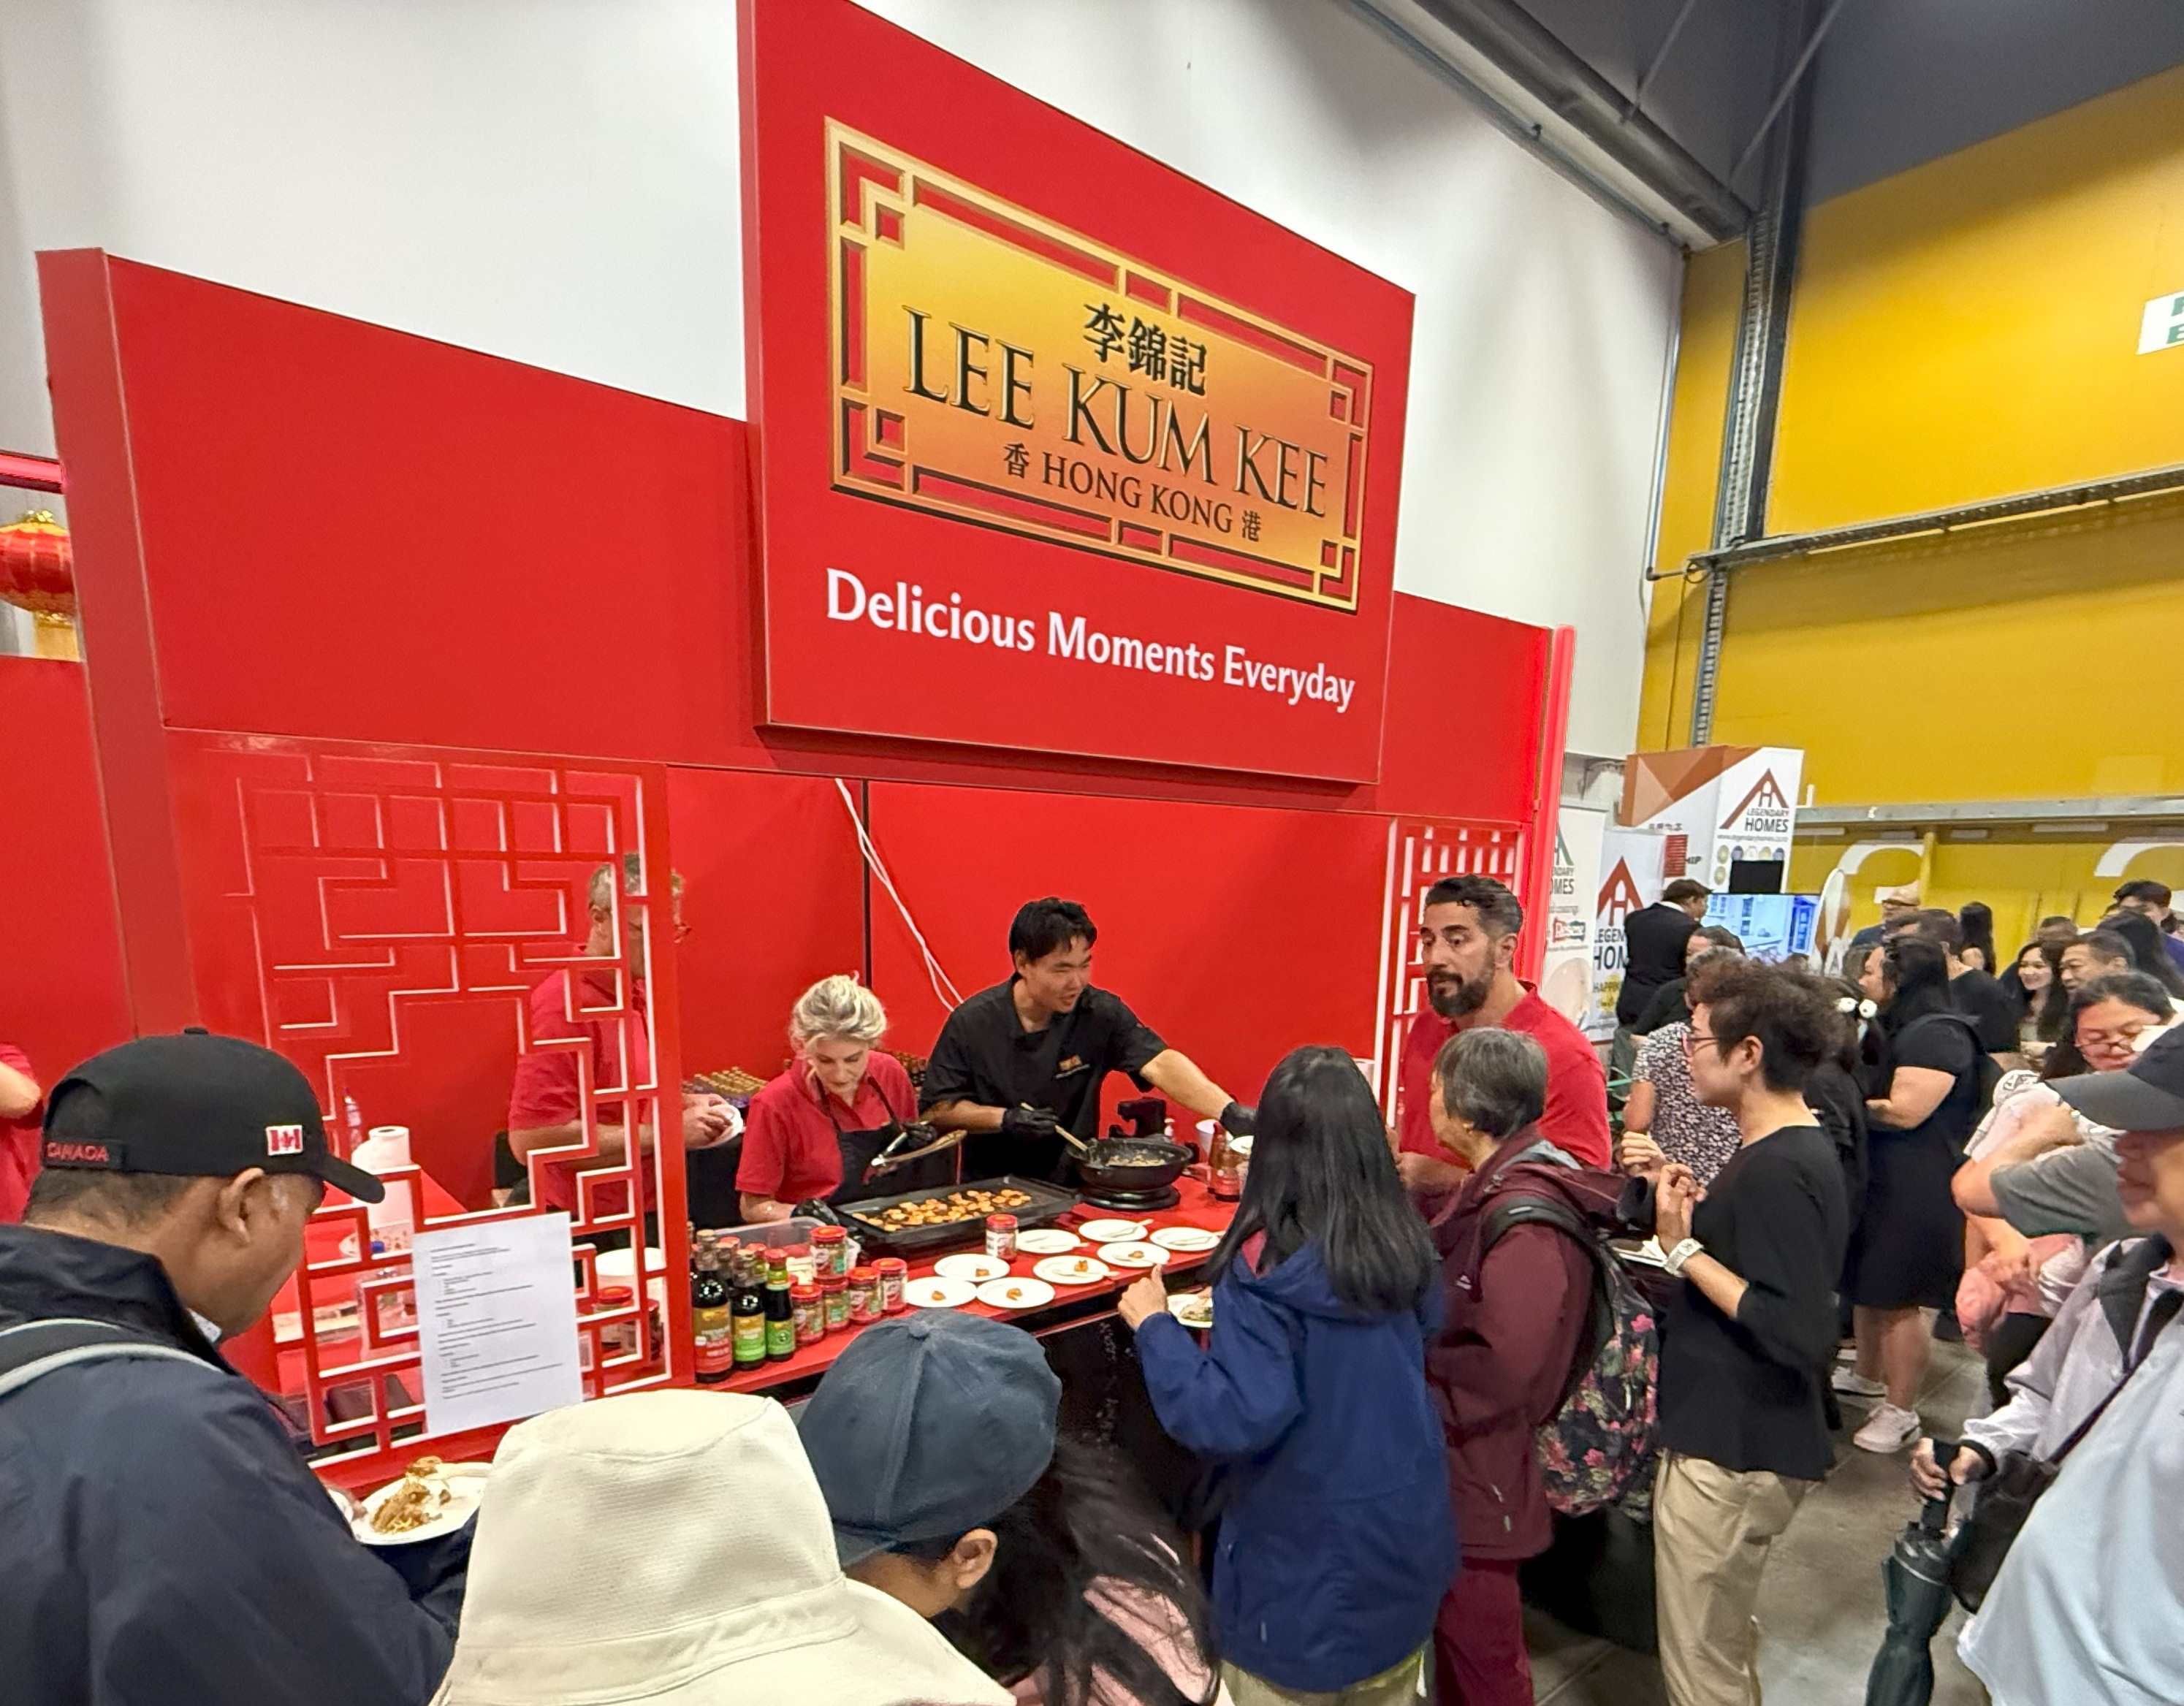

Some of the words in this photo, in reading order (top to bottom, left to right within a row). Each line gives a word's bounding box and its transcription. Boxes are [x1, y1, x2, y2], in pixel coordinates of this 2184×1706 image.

[1083, 303, 1207, 396] 李錦記
[902, 305, 1034, 430] LEE
[1062, 362, 1218, 486] KUM
[1234, 424, 1327, 518] KEE
[1004, 443, 1030, 479] 香
[1043, 452, 1142, 509] HONG
[1151, 483, 1233, 533] KONG
[1241, 509, 1261, 542] 港
[826, 568, 1035, 652] Delicious
[1047, 611, 1214, 681] Moments
[1223, 645, 1355, 713] Everyday
[1744, 817, 1789, 833] HOMES
[1746, 807, 1789, 818] LEGENDARY
[47, 1142, 110, 1163] CANADA
